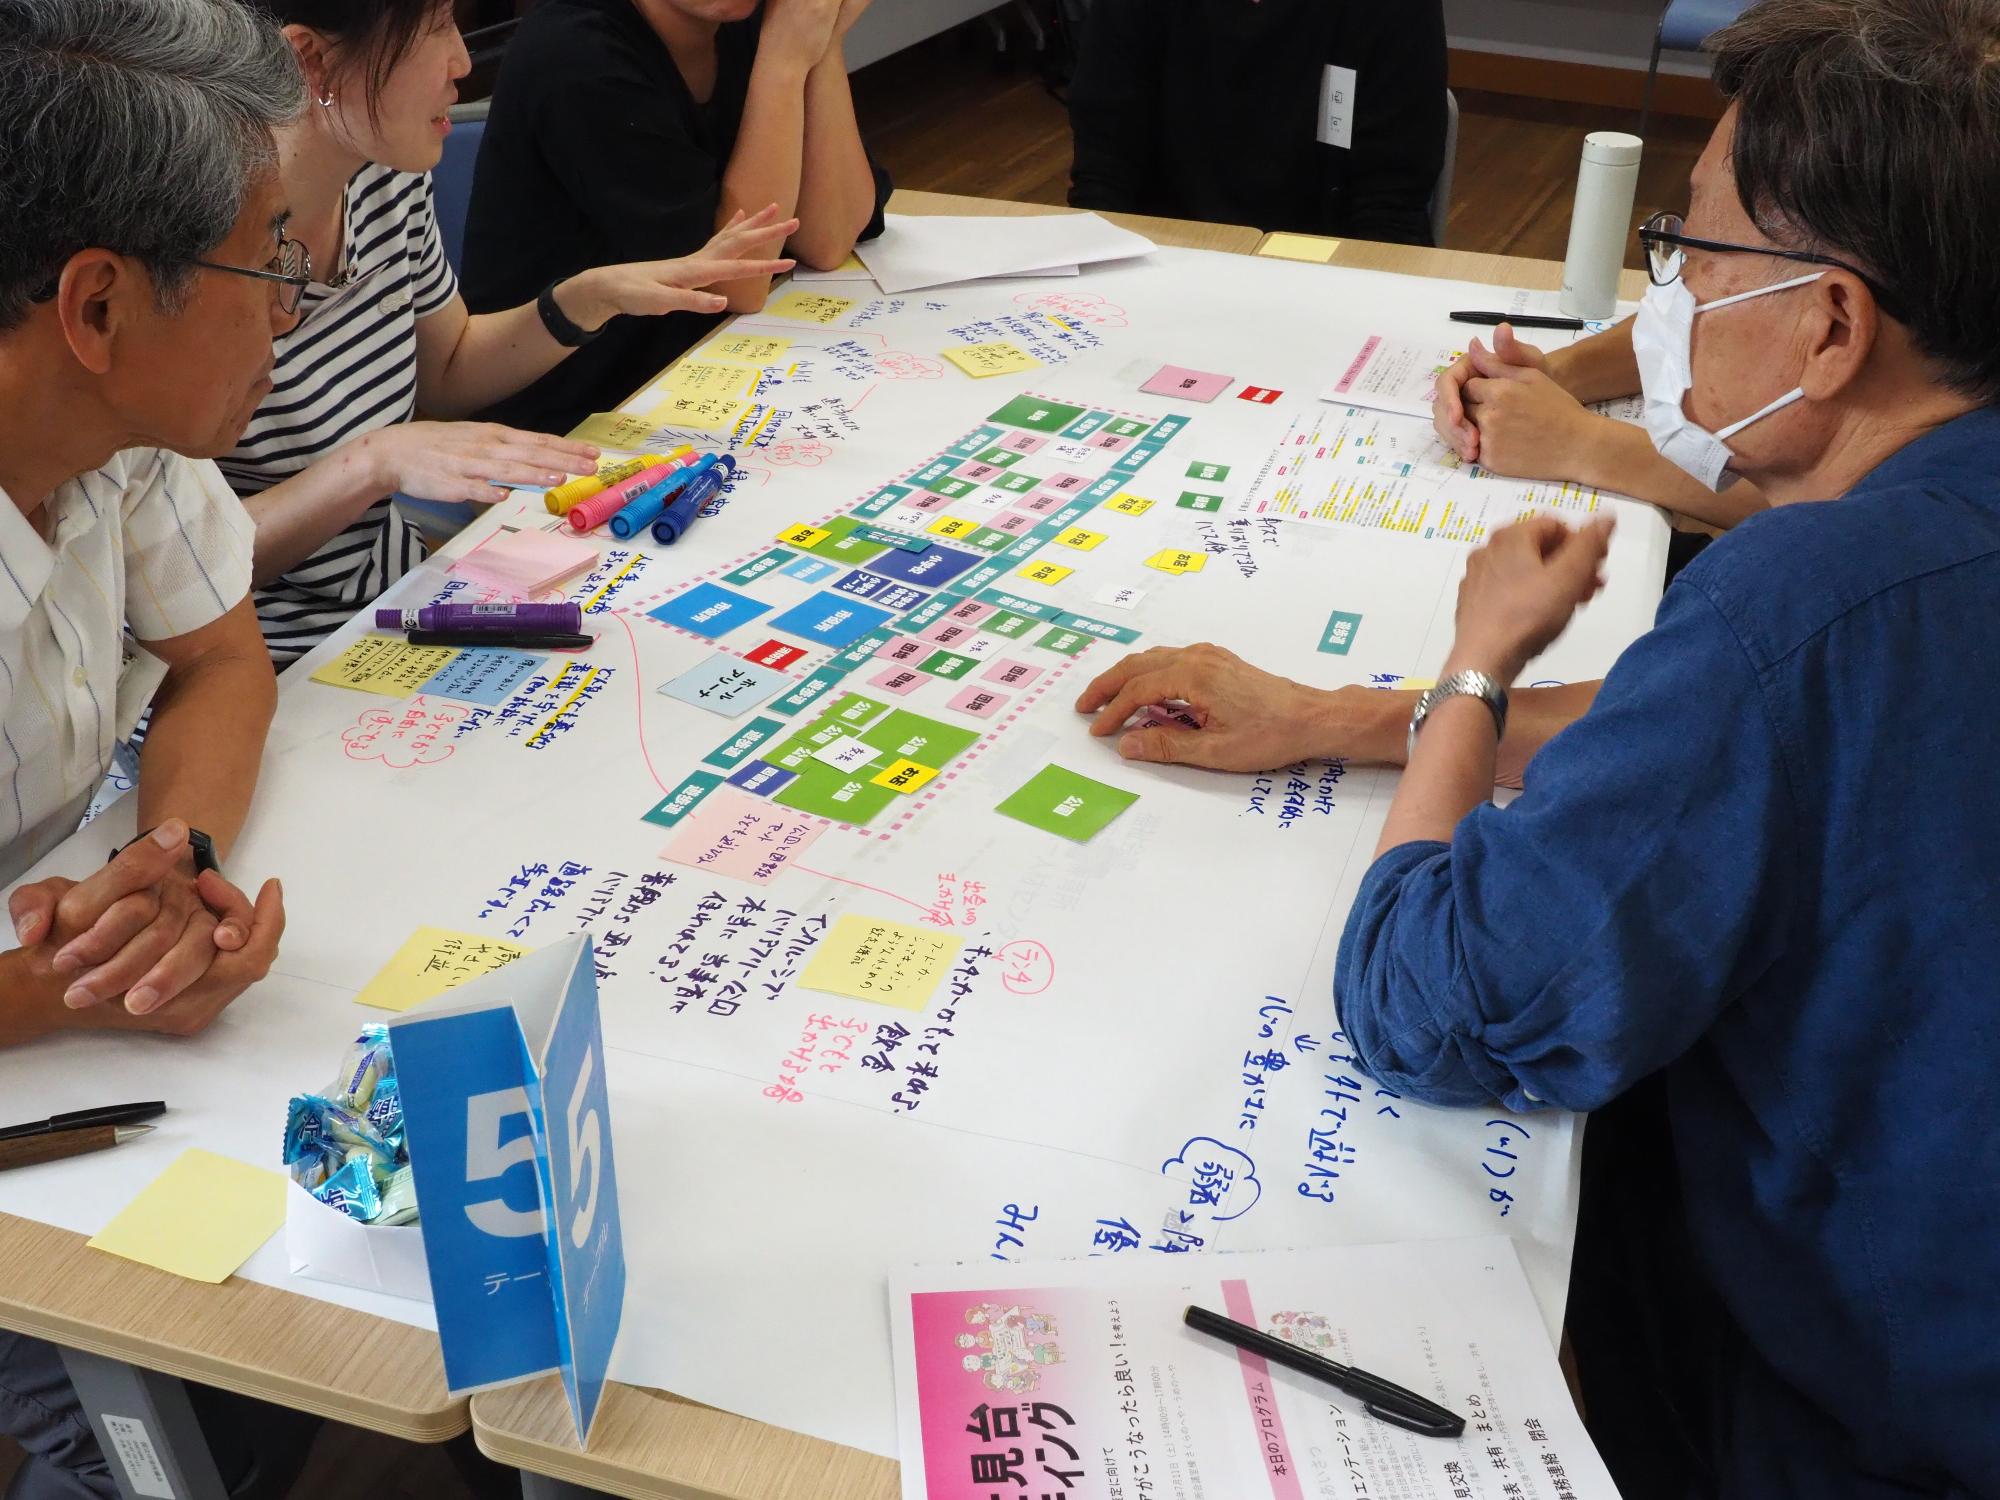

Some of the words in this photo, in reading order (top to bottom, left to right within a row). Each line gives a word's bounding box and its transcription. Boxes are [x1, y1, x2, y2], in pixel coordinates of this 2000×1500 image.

[967, 466, 992, 477] 団地
[1056, 477, 1079, 488] 団地
[916, 496, 941, 508] 団地
[1029, 497, 1054, 510] 団地
[1118, 498, 1139, 511] お店
[940, 522, 963, 534] お店
[1001, 517, 1025, 530] 団地
[791, 530, 815, 542] お店
[1068, 533, 1090, 546] お店
[908, 555, 943, 574] 小学校
[1173, 554, 1191, 567] お店
[843, 574, 870, 590] プール
[1032, 567, 1056, 579] お店
[853, 577, 880, 594] 小学校
[888, 590, 919, 608] 小学校
[691, 602, 731, 623] 市役所
[911, 602, 947, 624] 遊歩道
[953, 603, 982, 618] 団地
[814, 610, 853, 632] 市役所
[996, 617, 1024, 633] 緑地
[935, 627, 963, 642] 団地
[1051, 634, 1079, 649] 緑地
[845, 638, 884, 661] 遊歩道
[892, 643, 920, 659] 団地
[935, 657, 964, 674] 緑地
[1000, 665, 1028, 682] 団地
[699, 669, 745, 698] アリーナ
[719, 679, 757, 700] ホール
[885, 672, 916, 688] 団地
[786, 679, 827, 705] 遊歩道
[841, 701, 871, 720] 公園
[966, 693, 994, 711] 団地
[722, 730, 764, 758] 遊歩道
[810, 725, 842, 744] 公園
[897, 736, 927, 756] 公園
[780, 747, 812, 767] 公園
[742, 767, 779, 790] 図書館
[888, 767, 919, 786] お店
[661, 784, 704, 815] 遊歩道
[832, 782, 862, 802] 公園
[1053, 796, 1084, 816] 公園
[707, 910, 797, 1016] バリアフリー公園
[762, 914, 826, 1000] インクルーシブ
[861, 1022, 911, 1073] 飲食
[567, 1042, 600, 1249] 5
[463, 1086, 548, 1246] 5
[1247, 1381, 1290, 1475] 本日のプログラム
